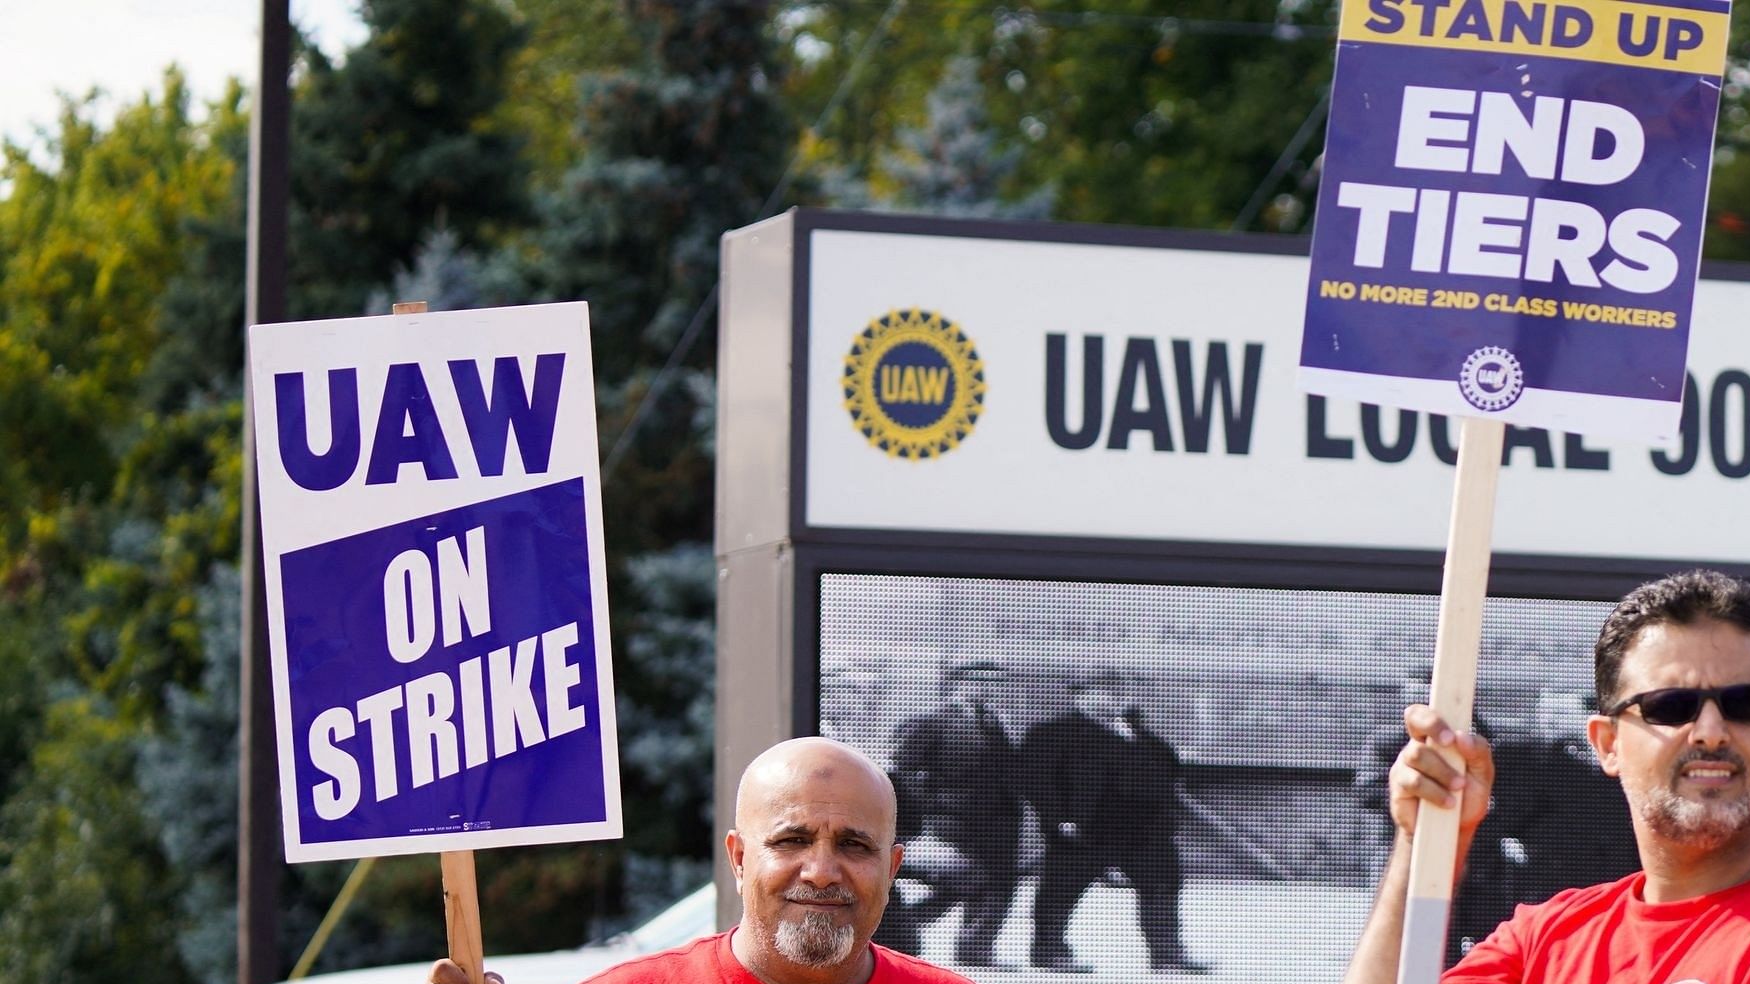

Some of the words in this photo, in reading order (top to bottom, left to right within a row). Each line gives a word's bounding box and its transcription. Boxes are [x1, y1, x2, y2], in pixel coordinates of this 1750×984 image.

[1364, 0, 1594, 48] STAND
[1617, 12, 1704, 61] UP
[1395, 85, 1645, 186] END
[1337, 181, 1681, 294] TIERS
[1320, 280, 1355, 300] NO
[1360, 284, 1428, 306] MORE
[1431, 289, 1480, 310] 2ND
[1483, 293, 1558, 318] CLASS
[1561, 300, 1677, 329] WORKERS
[274, 353, 566, 491] UAW
[881, 364, 949, 405] UAW
[1045, 332, 1264, 454] UAW
[384, 525, 492, 664] ON
[308, 621, 586, 820] STRIKE
